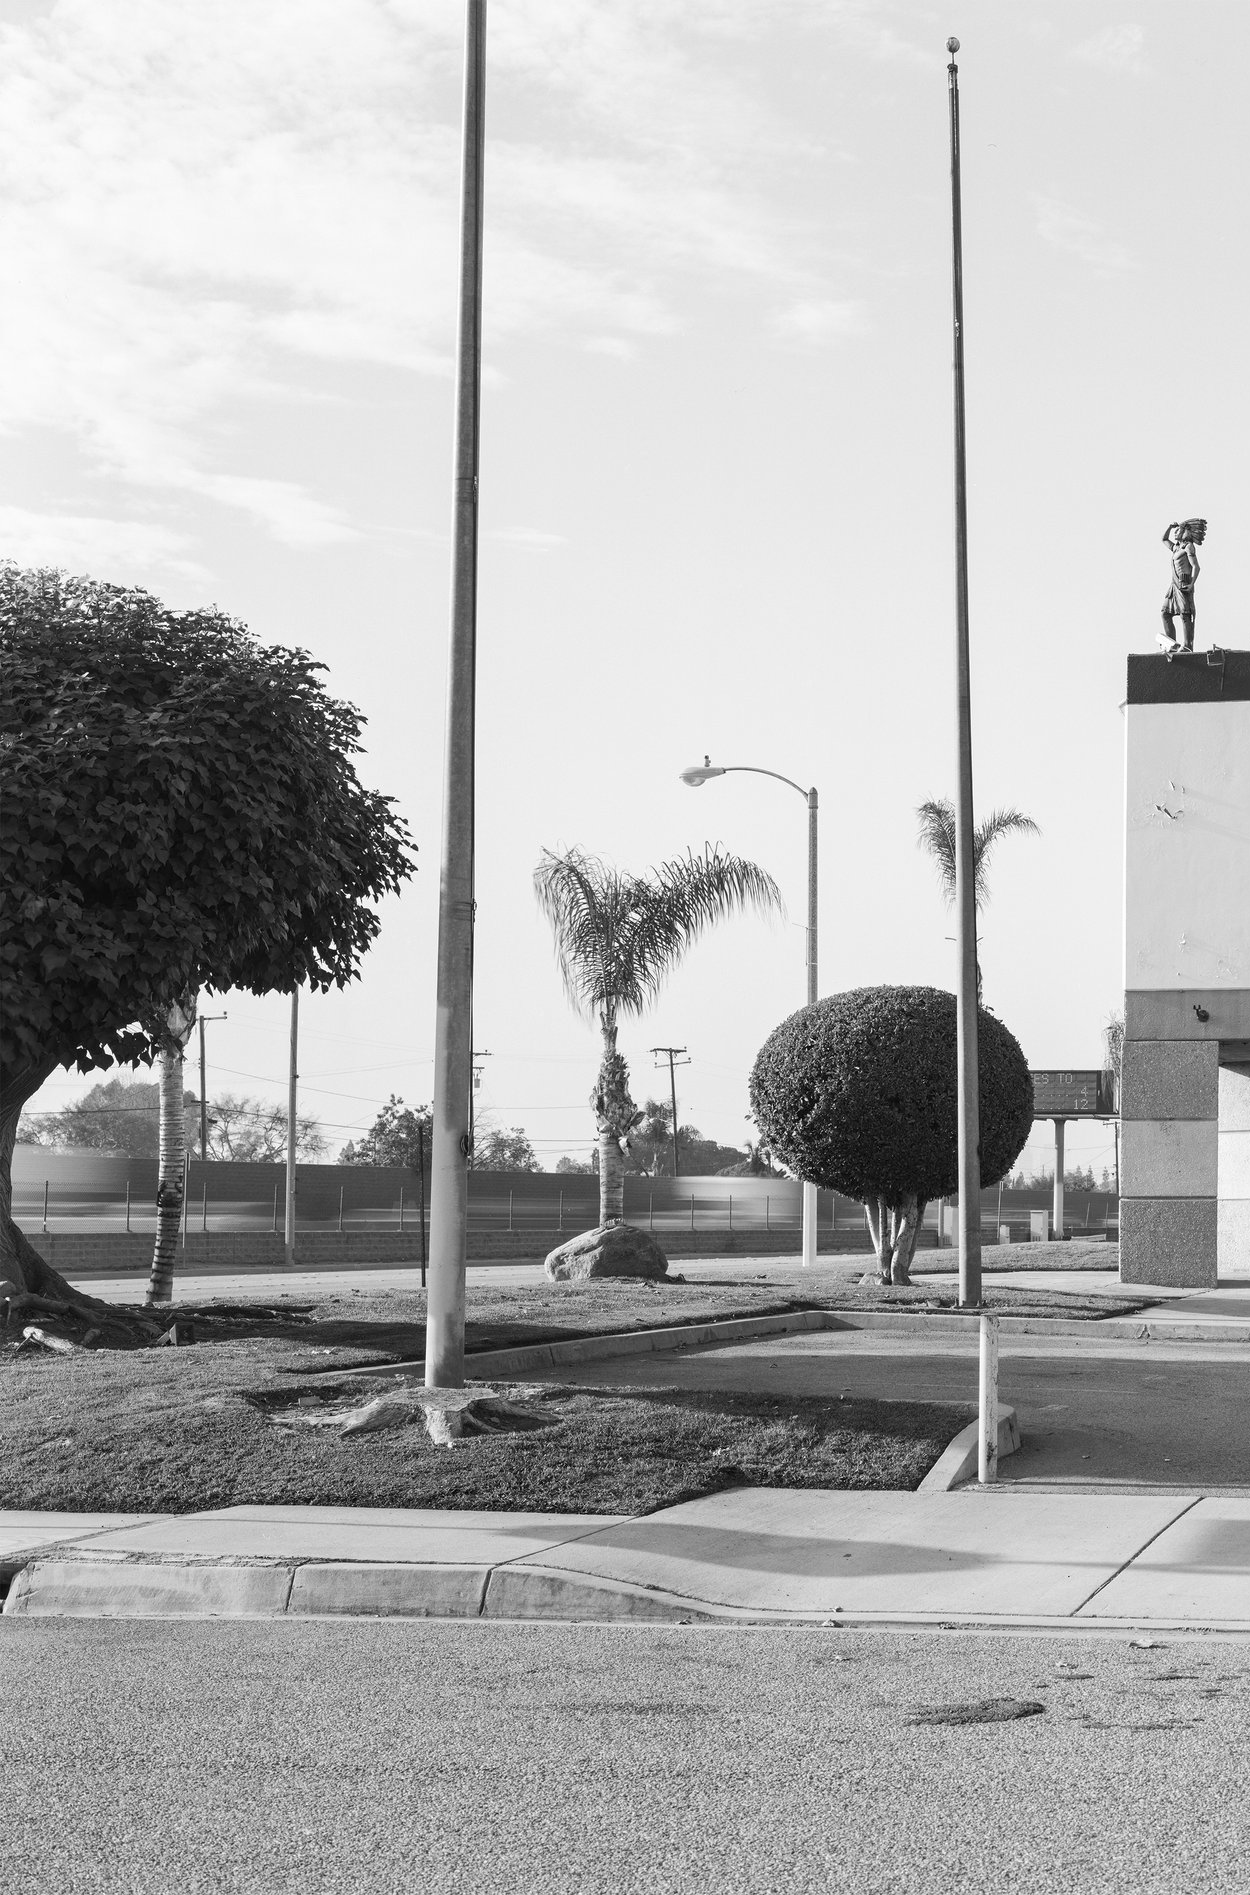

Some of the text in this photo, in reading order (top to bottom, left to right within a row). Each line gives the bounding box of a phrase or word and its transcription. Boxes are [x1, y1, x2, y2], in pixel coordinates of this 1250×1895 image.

[1057, 1073, 1073, 1084] TO
[1080, 1085, 1089, 1097] 4
[1073, 1099, 1089, 1110] 12
